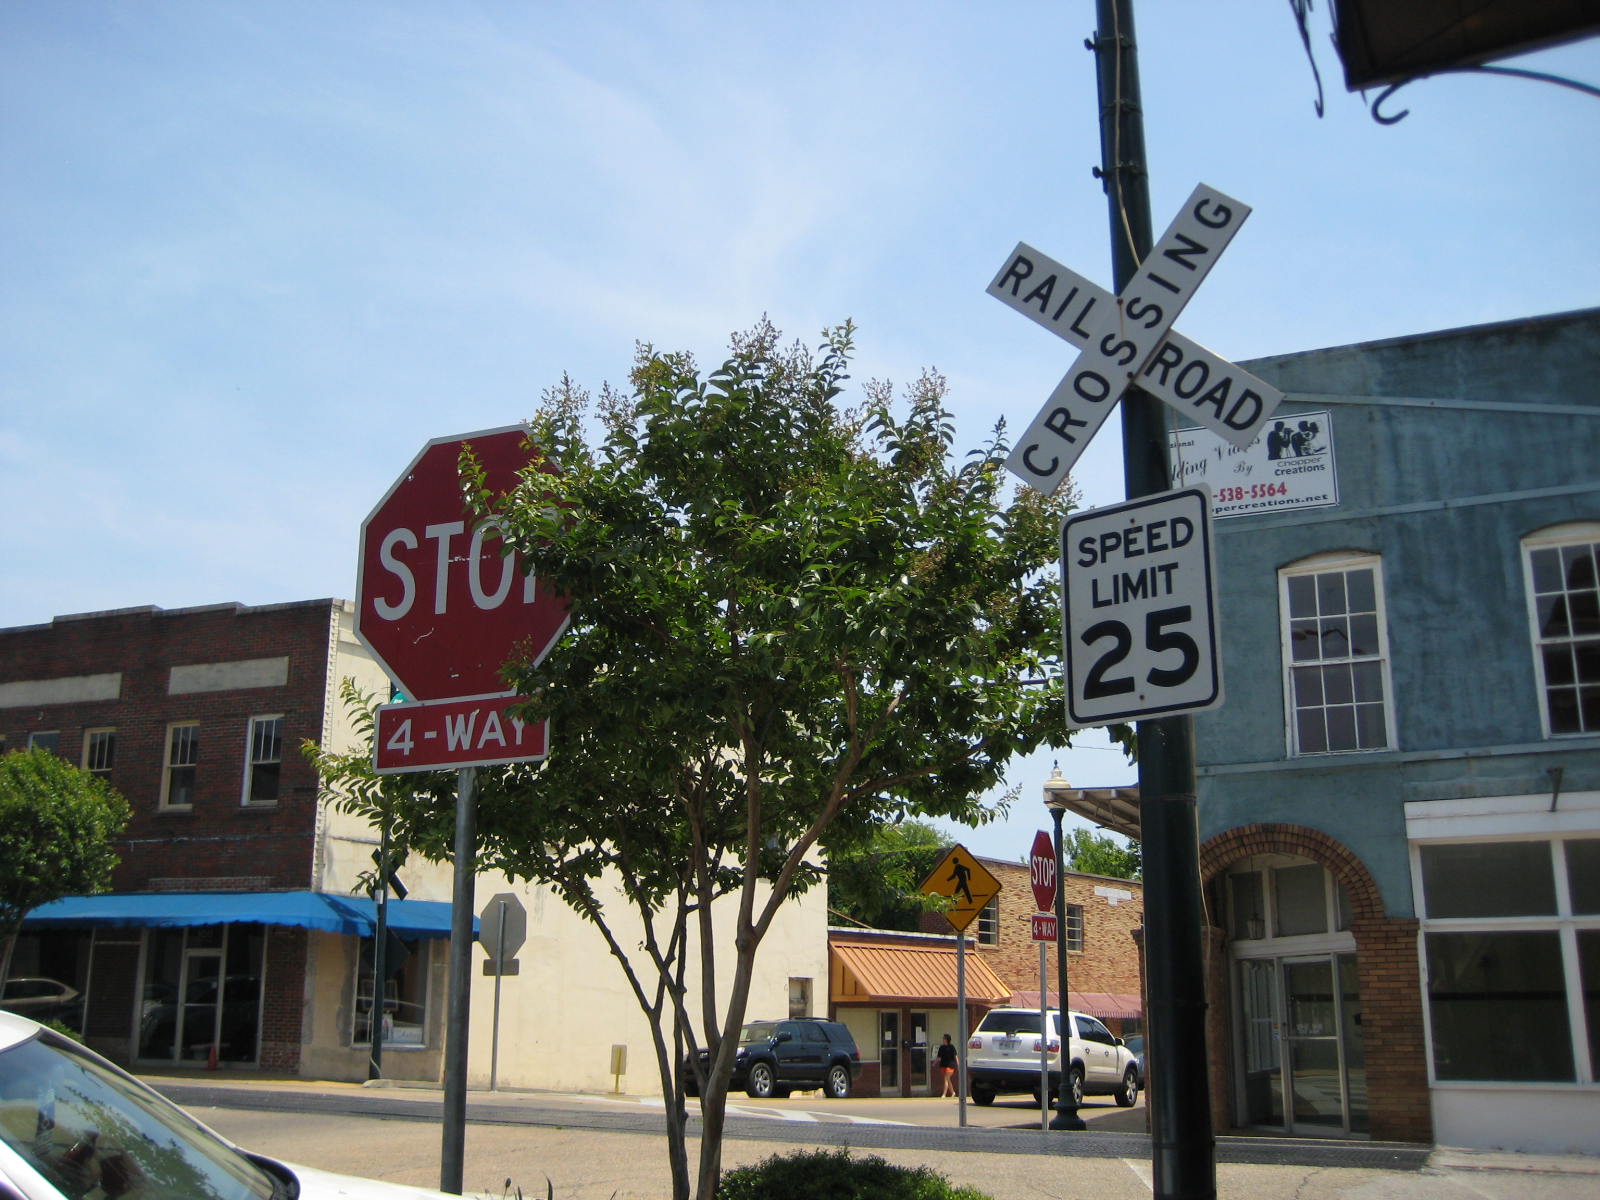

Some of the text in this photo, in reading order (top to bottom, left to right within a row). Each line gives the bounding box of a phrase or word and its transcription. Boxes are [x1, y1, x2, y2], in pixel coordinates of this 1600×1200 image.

[997, 255, 1264, 431] RAIL ROAD
[1022, 198, 1233, 477] CROSSING
[1212, 494, 1329, 514] percreations.net
[1077, 516, 1194, 567] SPEED
[1092, 562, 1179, 608] LIMIT
[1080, 605, 1200, 700] 25
[386, 709, 526, 756] 4-WAY
[1031, 856, 1055, 887] STOP
[1033, 921, 1055, 937] 4-WAY
